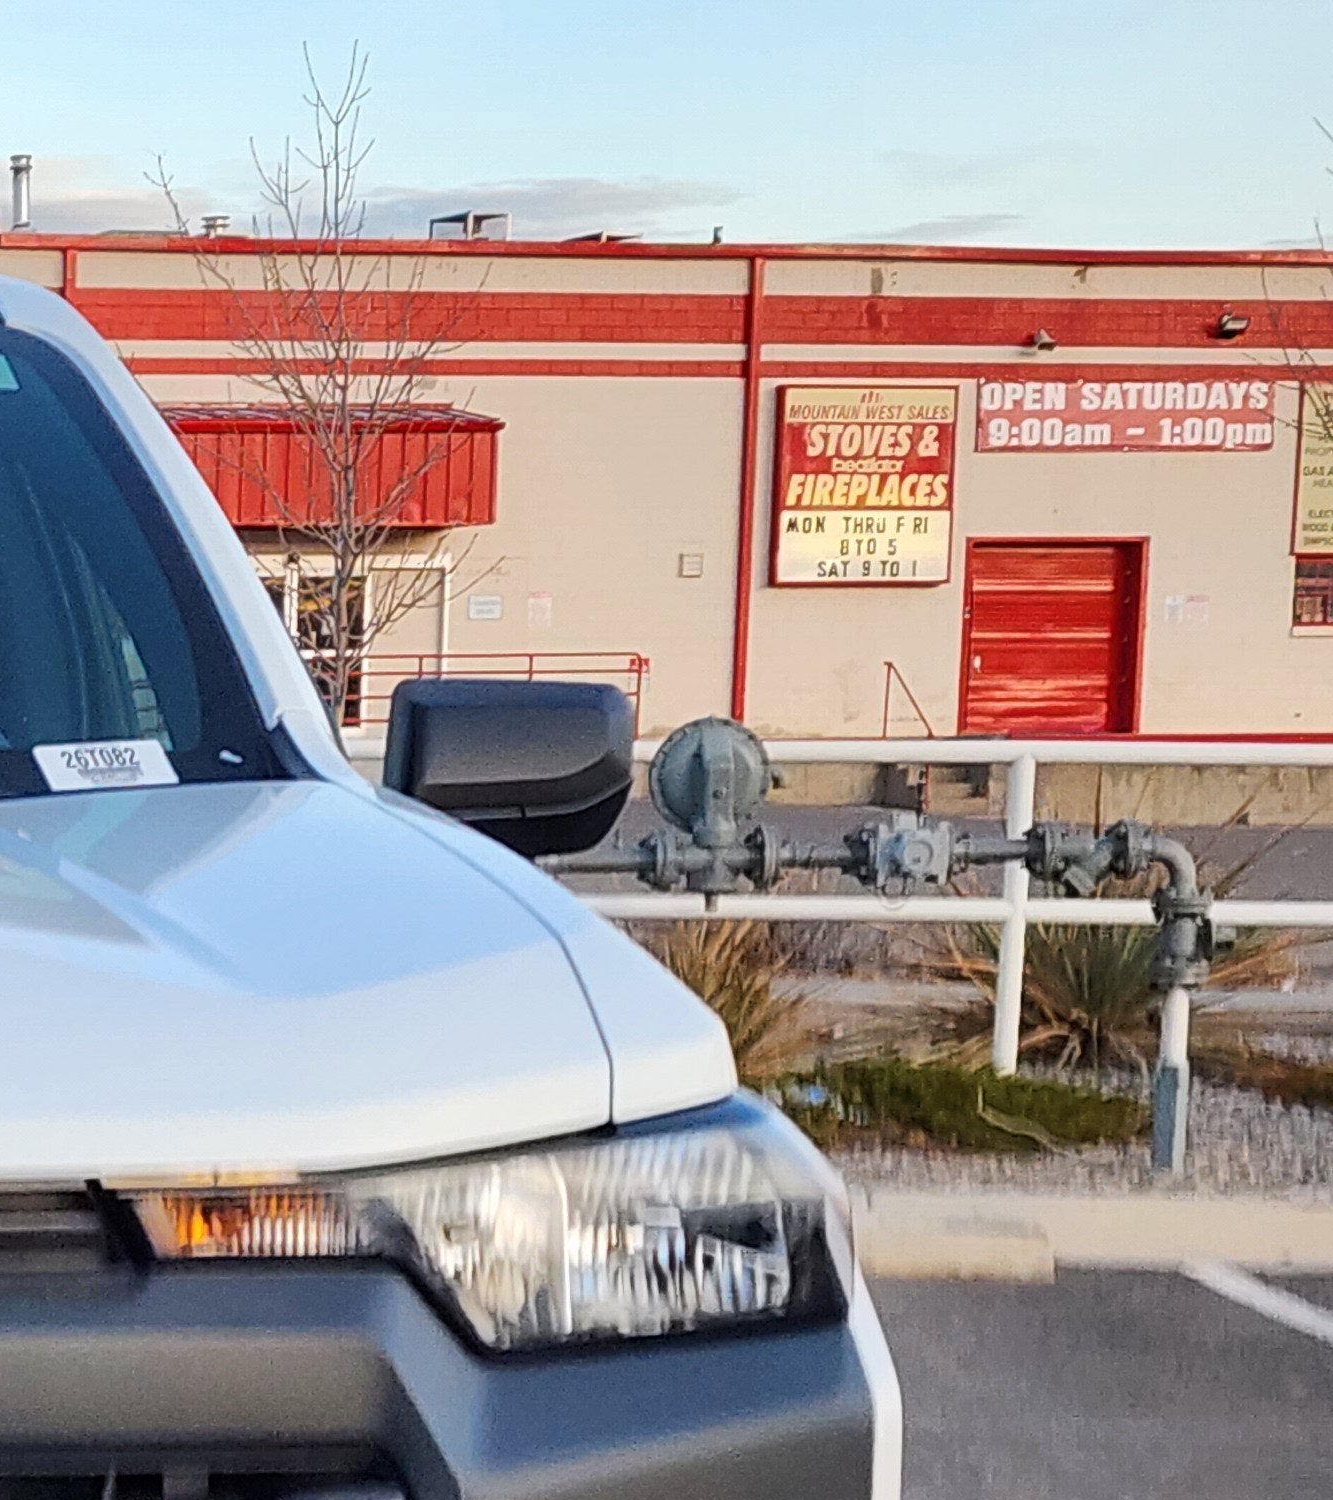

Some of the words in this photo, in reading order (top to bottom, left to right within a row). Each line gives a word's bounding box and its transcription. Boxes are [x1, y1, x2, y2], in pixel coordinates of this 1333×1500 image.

[981, 381, 1066, 411] OPEN
[789, 404, 861, 420] MOUNTAIN
[865, 404, 905, 420] WEST
[907, 405, 949, 420] SALES
[806, 424, 913, 457] STOVES
[917, 425, 940, 457] &
[988, 417, 1112, 446] 9:00am
[1159, 416, 1273, 449] 1:00pm
[785, 473, 949, 507] FIREPLACES
[786, 516, 826, 533] MON
[843, 516, 886, 534] THRU
[840, 539, 849, 556] 8
[855, 539, 877, 556] TO
[887, 539, 897, 556] 5
[817, 561, 850, 578] SAT
[862, 561, 871, 577] 9
[881, 561, 900, 577] TO
[60, 747, 141, 769] 26T082
